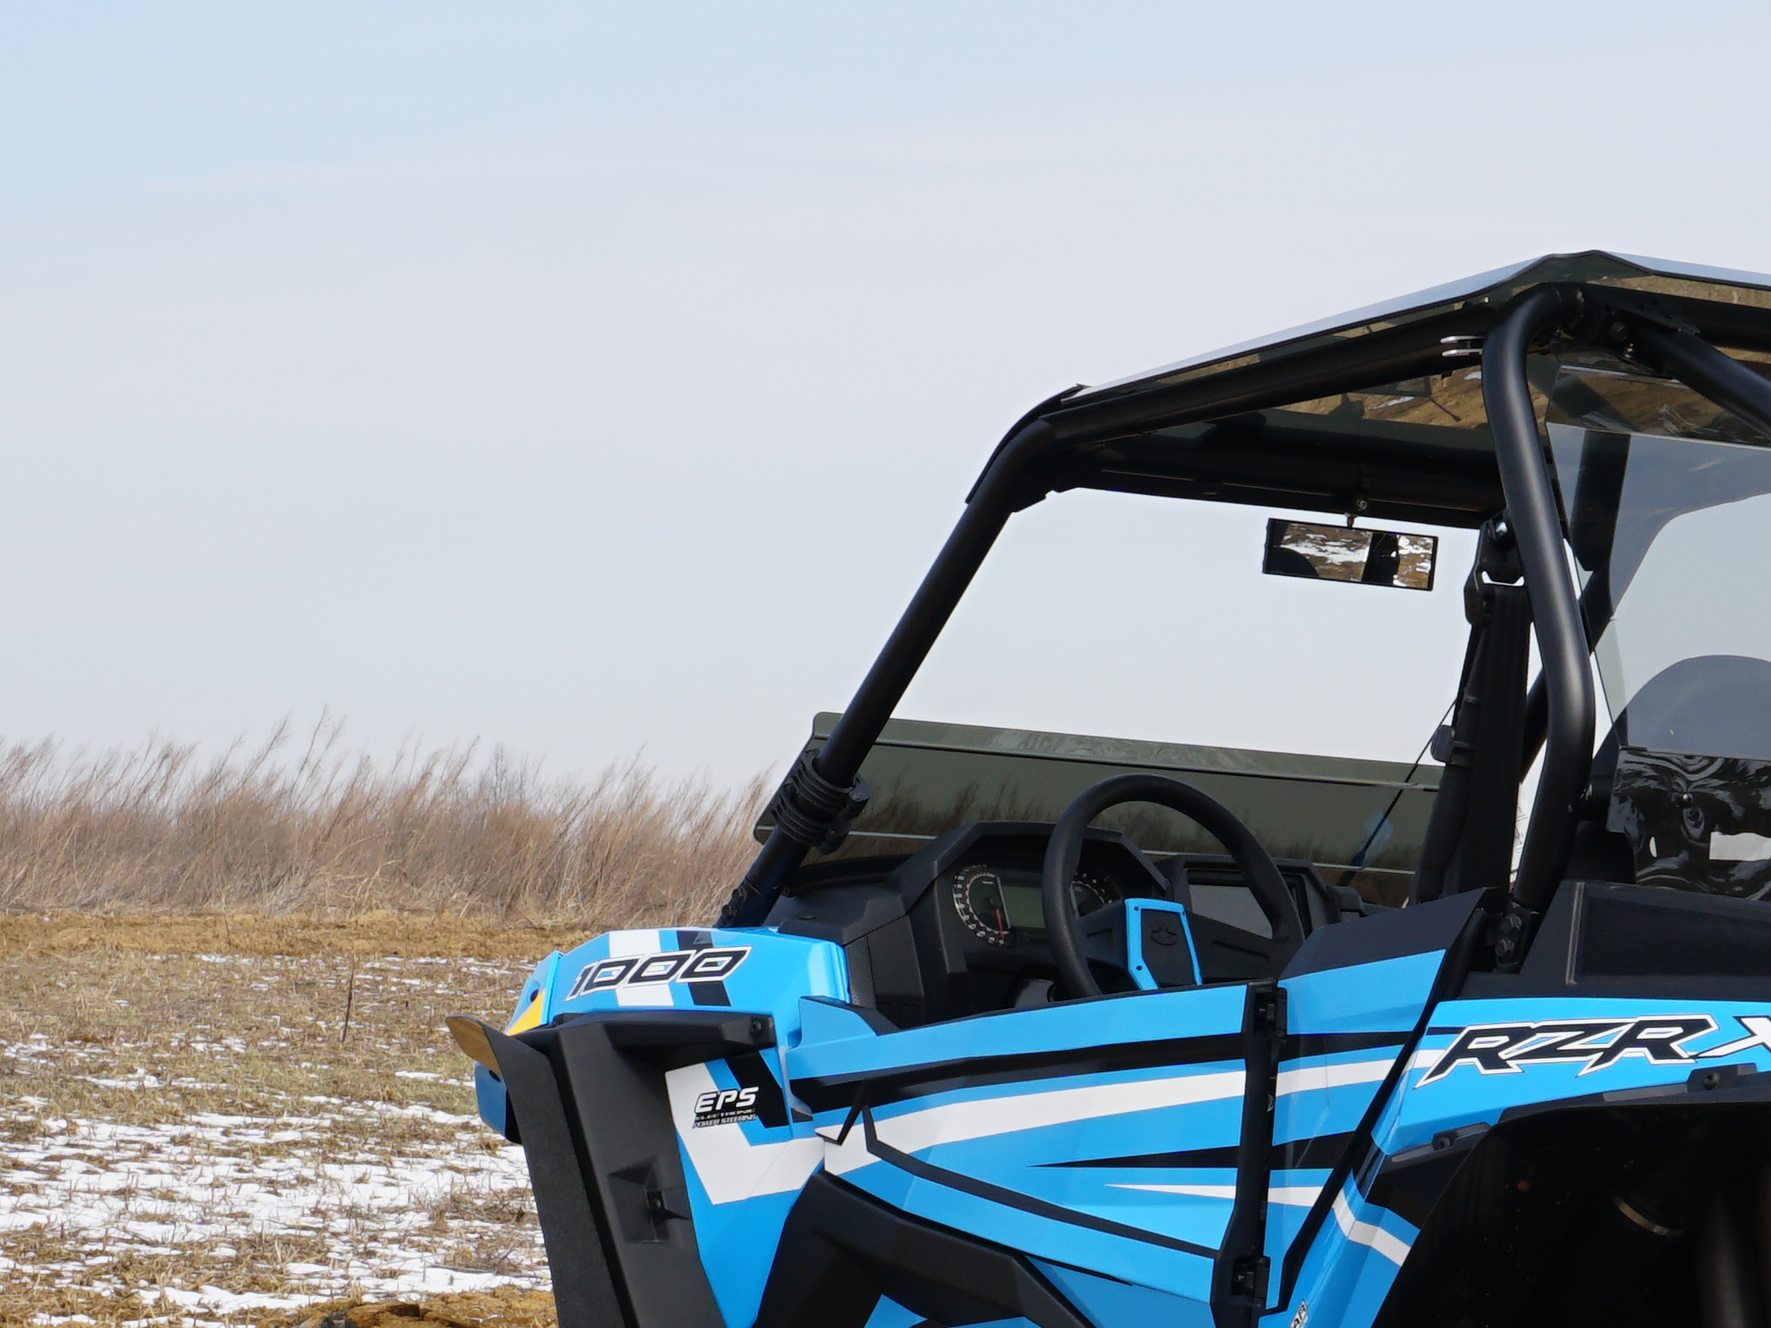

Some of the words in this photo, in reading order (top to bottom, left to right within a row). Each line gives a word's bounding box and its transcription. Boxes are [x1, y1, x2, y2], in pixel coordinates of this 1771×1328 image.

[565, 946, 753, 1002] 1000
[1414, 1014, 1719, 1089] RZR
[694, 1086, 760, 1114] EPS
